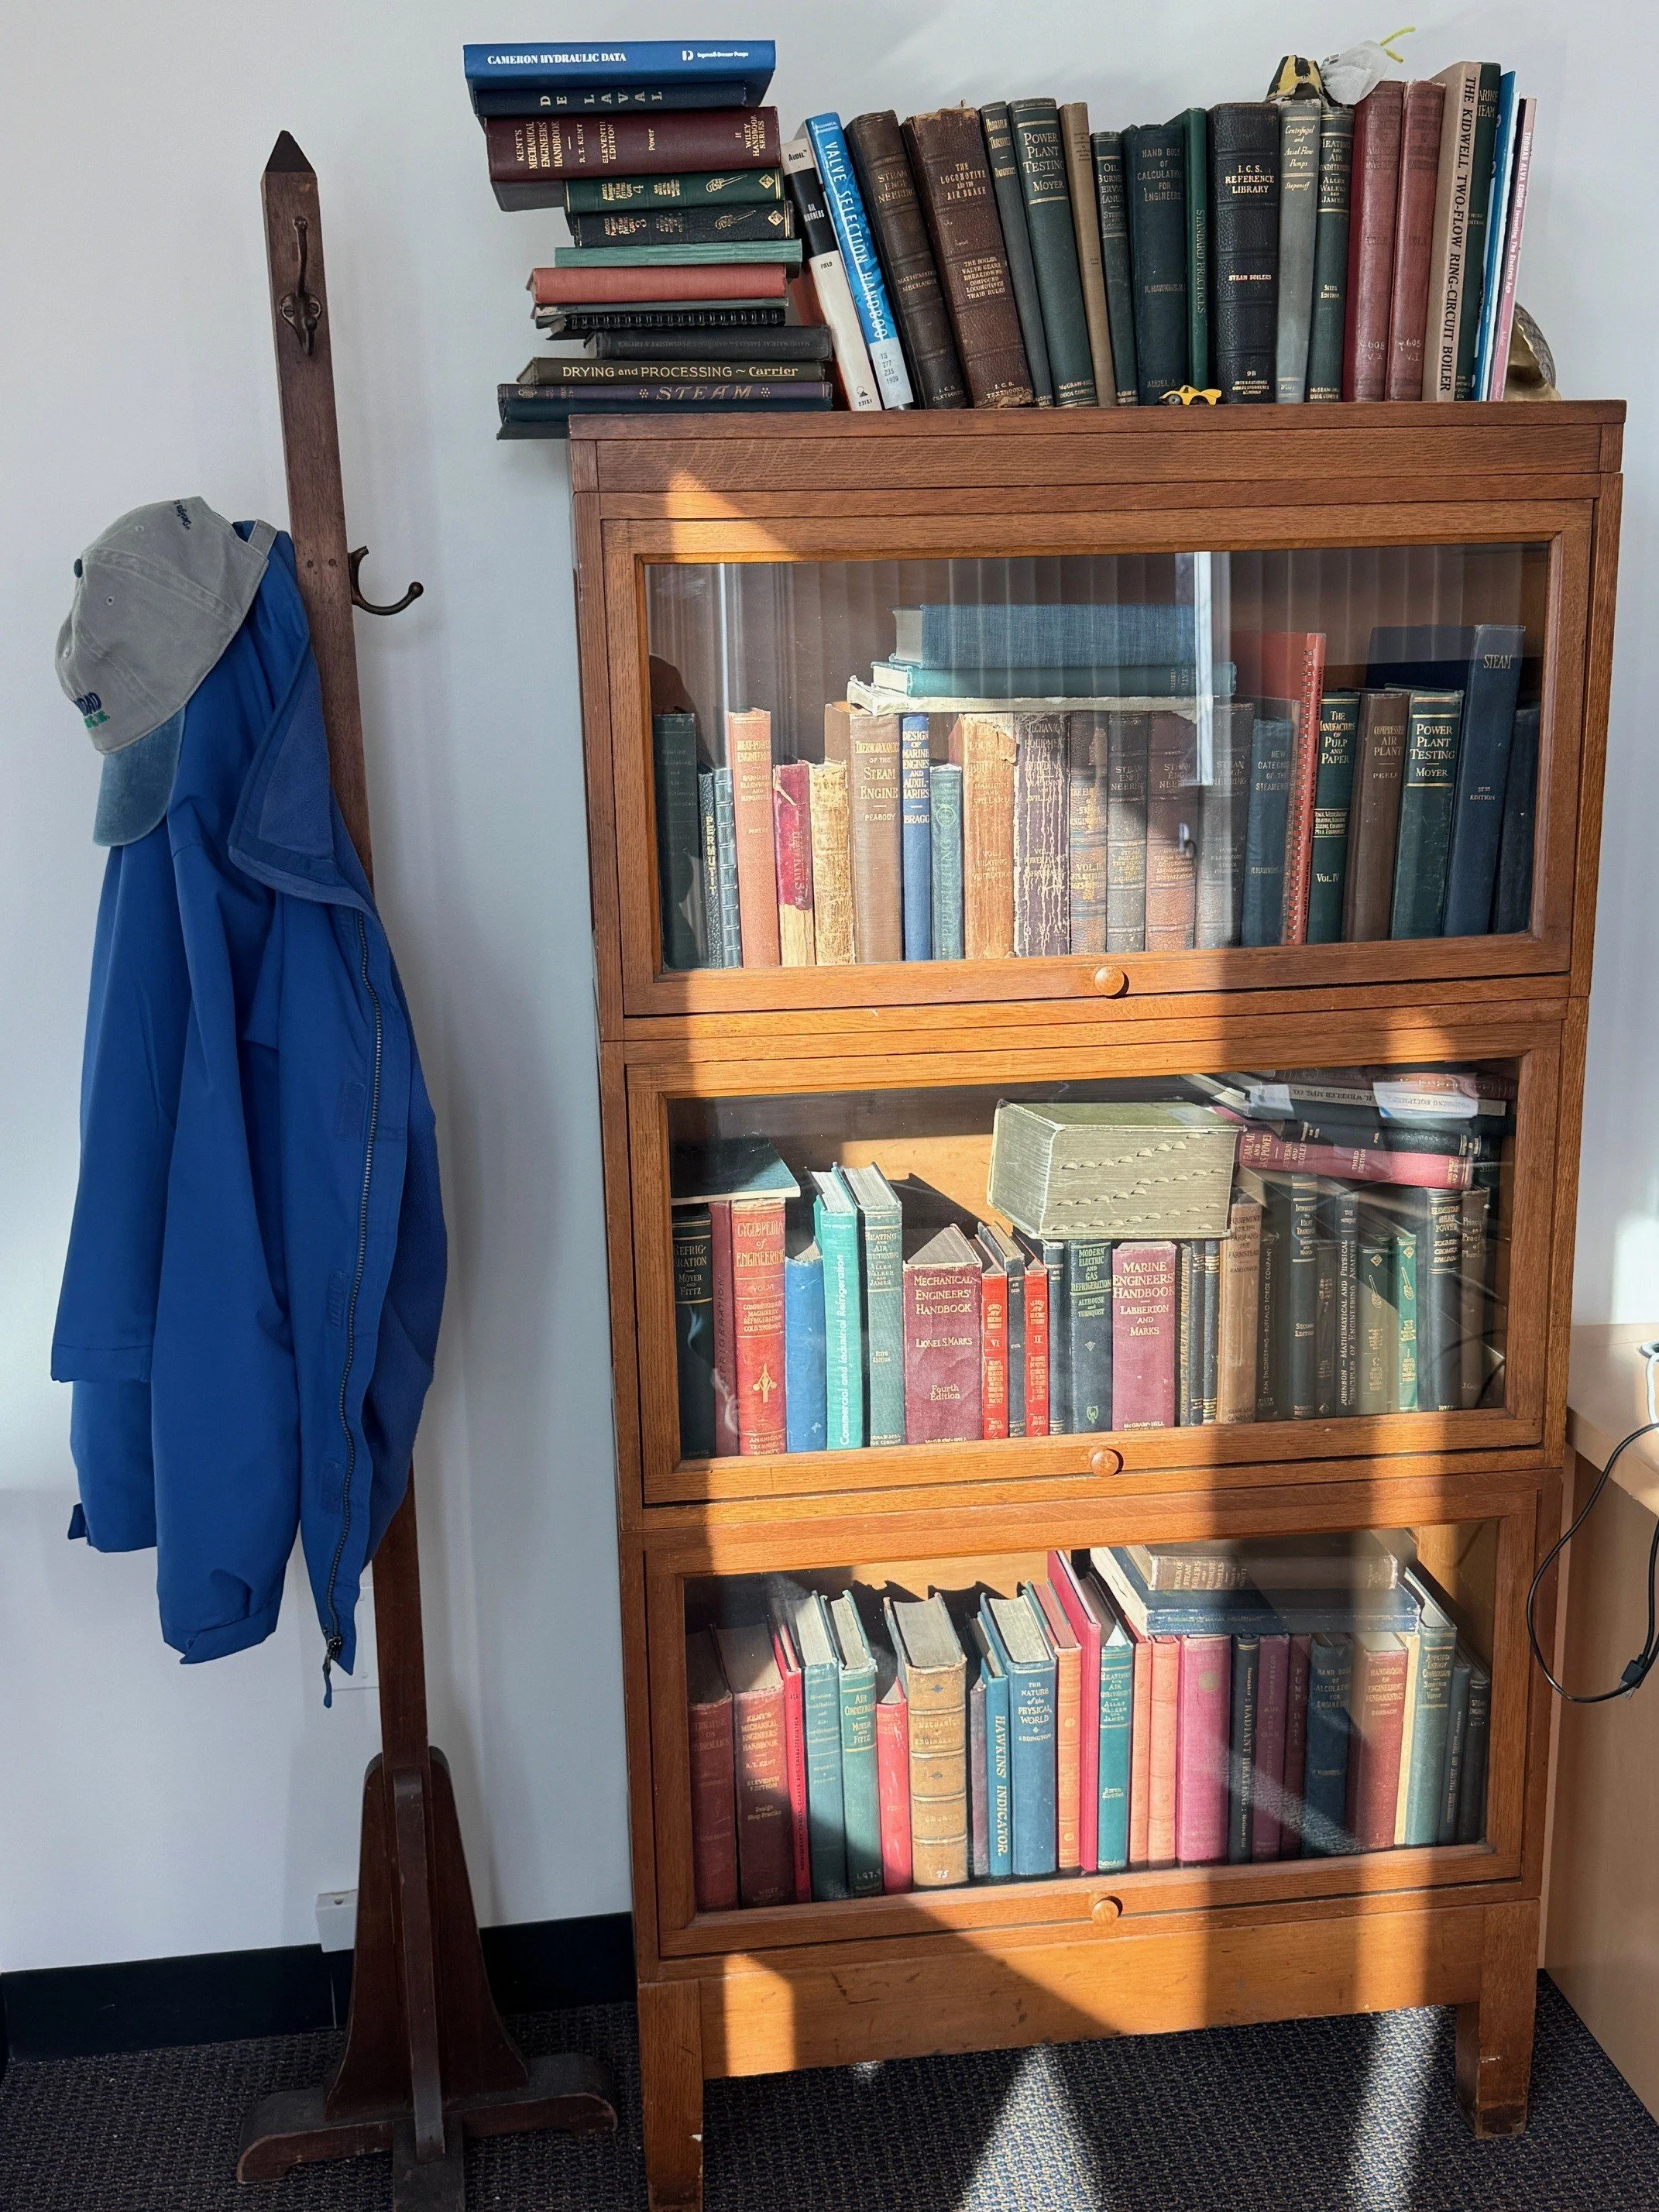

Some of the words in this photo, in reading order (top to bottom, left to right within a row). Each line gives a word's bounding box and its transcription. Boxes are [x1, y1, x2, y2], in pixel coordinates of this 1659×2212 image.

[487, 55, 538, 64] CAMERON
[541, 53, 599, 64] HYDRAULIC
[602, 53, 627, 62] DATA
[1465, 77, 1476, 103] THE
[584, 91, 663, 105] LAVAL
[744, 123, 752, 149] WILEY
[750, 115, 760, 157] HANDBOOK
[757, 121, 766, 149] SERIES
[1285, 125, 1315, 135] Centrifugal
[551, 120, 563, 167] HANDBOOK
[599, 122, 609, 164] ELEVENTH
[607, 124, 617, 160] EDITION
[647, 129, 656, 151] Power
[1024, 132, 1058, 146] POWER
[1458, 108, 1473, 169] KIDWELL
[515, 129, 524, 162] KENT'S
[526, 122, 538, 170] MECHANICAL
[1520, 132, 1532, 160] THOMAS
[1027, 146, 1059, 159] PLANT
[1142, 148, 1162, 158] HAND
[956, 163, 969, 172] THE
[1023, 160, 1064, 173] TESTING
[1104, 163, 1119, 173] OIL
[1245, 165, 1253, 173] C.
[1255, 164, 1262, 173] S.
[1290, 160, 1308, 169] Pumps
[878, 170, 907, 183] STEAM
[940, 170, 986, 184] LOCOMOTIVE
[1224, 175, 1274, 184] REFERENCE
[1518, 163, 1530, 184] ALVA
[633, 184, 644, 194] 4
[1032, 180, 1064, 192] MOYER
[1231, 185, 1269, 194] LIBRARY
[947, 191, 960, 201] AIR
[963, 187, 987, 198] BRAKE
[1514, 186, 1527, 208] EDISON
[1451, 175, 1467, 247] TWO-FLOW
[1510, 210, 1523, 238] Inventing
[824, 141, 847, 183] VALVE
[839, 191, 868, 263] SELECTION
[862, 272, 888, 339] HANDBOO
[1196, 209, 1206, 259] STANDARD
[1509, 240, 1519, 252] The
[978, 256, 997, 265] BOILER
[1507, 254, 1517, 277] Electric
[961, 265, 982, 274] VALVE
[983, 262, 1001, 270] GEARS
[963, 270, 1002, 281] BREAKDOWNS
[969, 276, 999, 287] COMPOUND
[966, 280, 1005, 293] LOCOMOTIVES
[1197, 263, 1207, 314] PRACTICES
[1504, 279, 1513, 294] Age
[967, 291, 986, 300] TRAIN
[988, 287, 1005, 296] RULES
[1444, 253, 1462, 341] RING-CIRCUIT
[563, 367, 614, 377] DRYING
[641, 367, 732, 377] PROCESSING
[749, 366, 798, 377] Carrier
[1440, 346, 1454, 391] BOILER
[1147, 379, 1170, 388] AUDEL
[656, 385, 754, 400] STEAM
[1483, 654, 1513, 669] STEAM
[1330, 710, 1345, 720] THE
[902, 730, 929, 741] DESIGN
[1374, 725, 1404, 735] COMPRESSED
[1416, 725, 1452, 735] POWER
[1324, 736, 1347, 748] PULP
[1381, 737, 1396, 745] AIR
[1417, 736, 1451, 747] PLANT
[902, 749, 929, 759] MARINE
[1374, 746, 1402, 756] PLANT
[1410, 749, 1455, 761] TESTING
[902, 759, 929, 769] ENGINES
[1321, 752, 1348, 764] PAPER
[864, 767, 896, 780] STEAM
[1416, 768, 1448, 778] MOYER
[903, 778, 929, 788] AUXIL-
[860, 785, 898, 799] ENGINE
[705, 816, 716, 895] PERMUTIT
[1316, 873, 1331, 883] VOL.
[737, 1221, 785, 1237] CYCLOPEDIA
[1435, 1223, 1457, 1232] POWER
[756, 1238, 766, 1249] of
[873, 1244, 888, 1252] AIR
[1078, 1248, 1104, 1257] MODERN
[737, 1251, 785, 1267] ENGINEERING
[1078, 1256, 1104, 1265] ELECTRIC
[1122, 1261, 1166, 1273] MARINE
[678, 1274, 702, 1283] MOYER
[914, 1275, 973, 1286] MECHANICAL
[1085, 1272, 1097, 1280] GAS
[680, 1286, 702, 1296] FITTZ
[836, 1254, 846, 1317] Refrigeration
[1071, 1279, 1111, 1292] REFRIGERATION
[915, 1289, 971, 1300] ENGINEERS'
[1113, 1286, 1175, 1300] HANDBOOK
[1078, 1297, 1104, 1306] ALTHOUSE
[916, 1303, 972, 1315] HANDBOOK
[1078, 1308, 1104, 1317] TURNQUIST
[1120, 1304, 1169, 1315] LABBERTON
[1136, 1316, 1153, 1324] AND
[1129, 1327, 1159, 1337] MARKS
[839, 1318, 848, 1359] Industrial
[915, 1338, 942, 1347] LIONEL
[947, 1338, 973, 1346] MARKS
[1349, 1347, 1355, 1357] OF
[839, 1362, 850, 1383] and
[930, 1385, 960, 1393] Fourth
[930, 1392, 960, 1400] Edition
[839, 1388, 850, 1446] Commercial
[1021, 1688, 1049, 1696] NATURE
[854, 1695, 867, 1704] AIR
[1027, 1695, 1036, 1705] of
[1018, 1703, 1052, 1715] PHYSICAL
[1020, 1715, 1049, 1725] WORLD
[1243, 1705, 1252, 1753] RADIANT
[1018, 1733, 1052, 1742] EDDINGTON
[1242, 1757, 1252, 1805] HEATING
[996, 1785, 1008, 1857] INDICATOR.
